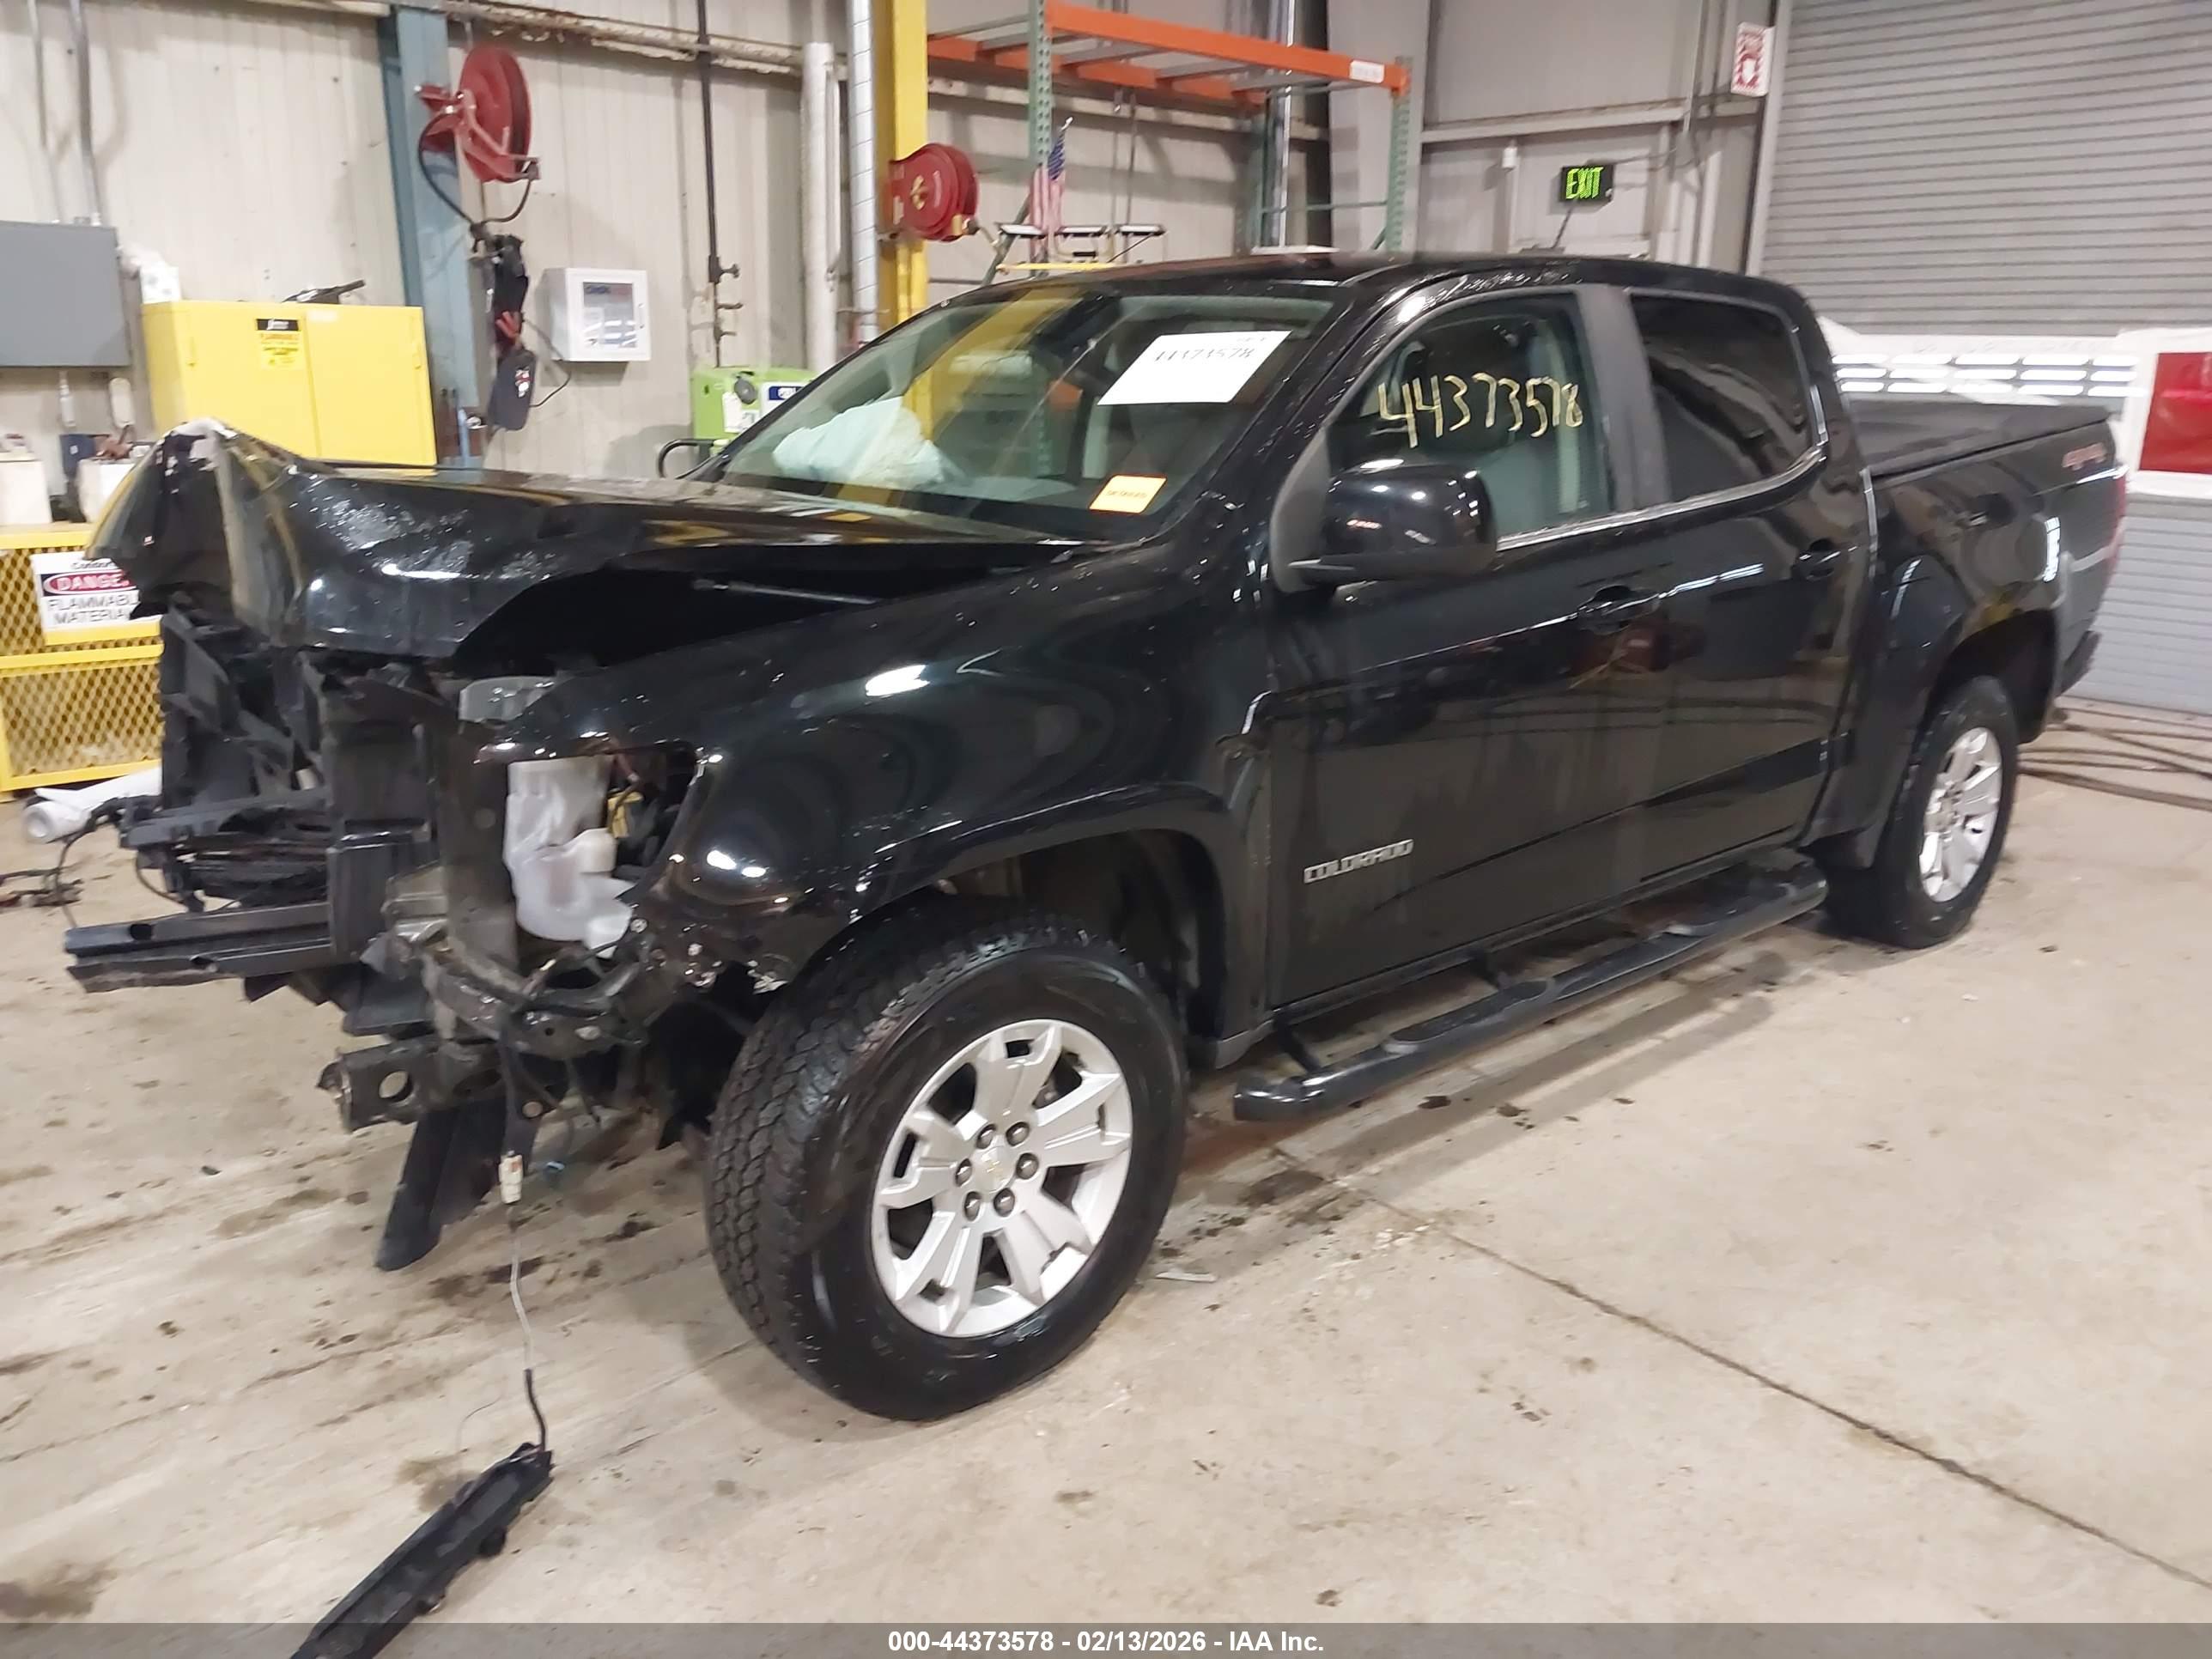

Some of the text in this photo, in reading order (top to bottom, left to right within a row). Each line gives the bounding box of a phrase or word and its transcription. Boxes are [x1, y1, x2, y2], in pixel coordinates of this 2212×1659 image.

[1565, 166, 1604, 198] EXIT
[1377, 372, 1583, 448] 44373578
[56, 573, 130, 592] DANGE
[47, 593, 141, 611] FLAMMABL
[53, 607, 129, 624] MATERIA
[1304, 838, 1414, 884] COLORADO
